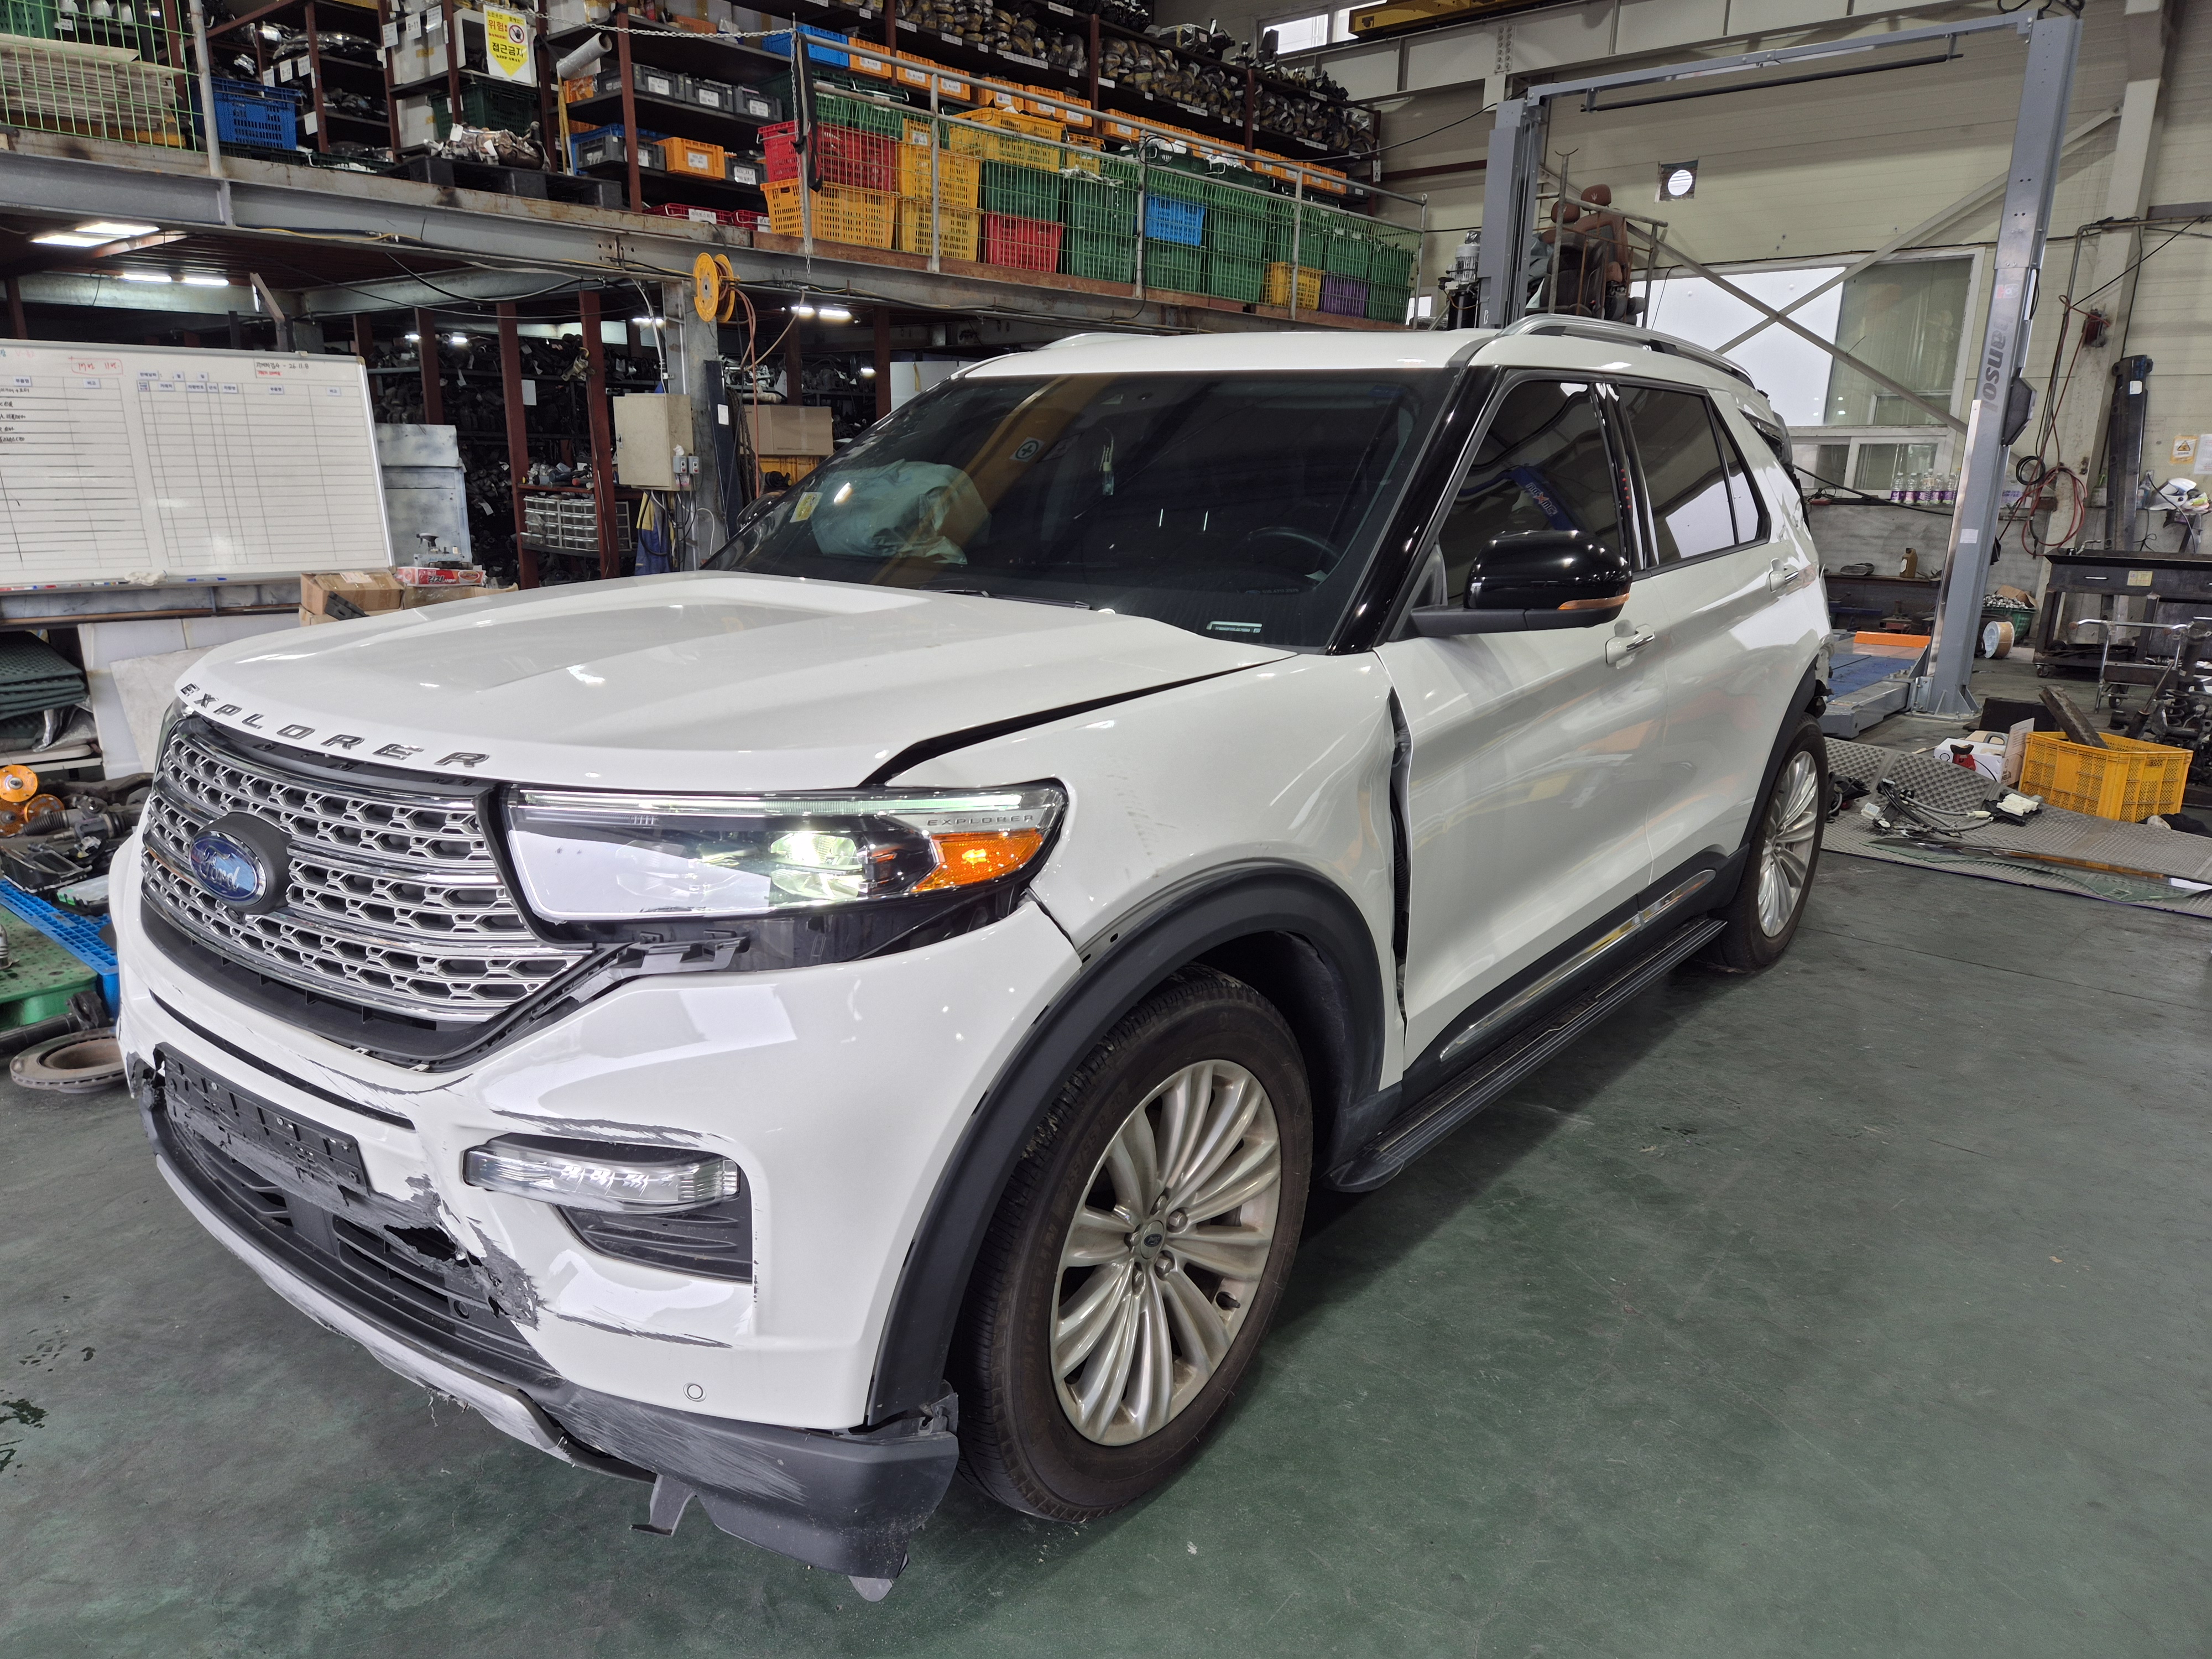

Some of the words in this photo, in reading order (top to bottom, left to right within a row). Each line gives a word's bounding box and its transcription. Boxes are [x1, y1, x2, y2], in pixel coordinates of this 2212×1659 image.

[488, 20, 508, 32] 위험!
[492, 42, 524, 58] 접근금지
[180, 682, 491, 768] EXPLORER
[926, 815, 1034, 827] EXPLORER
[200, 845, 241, 892] Ford
